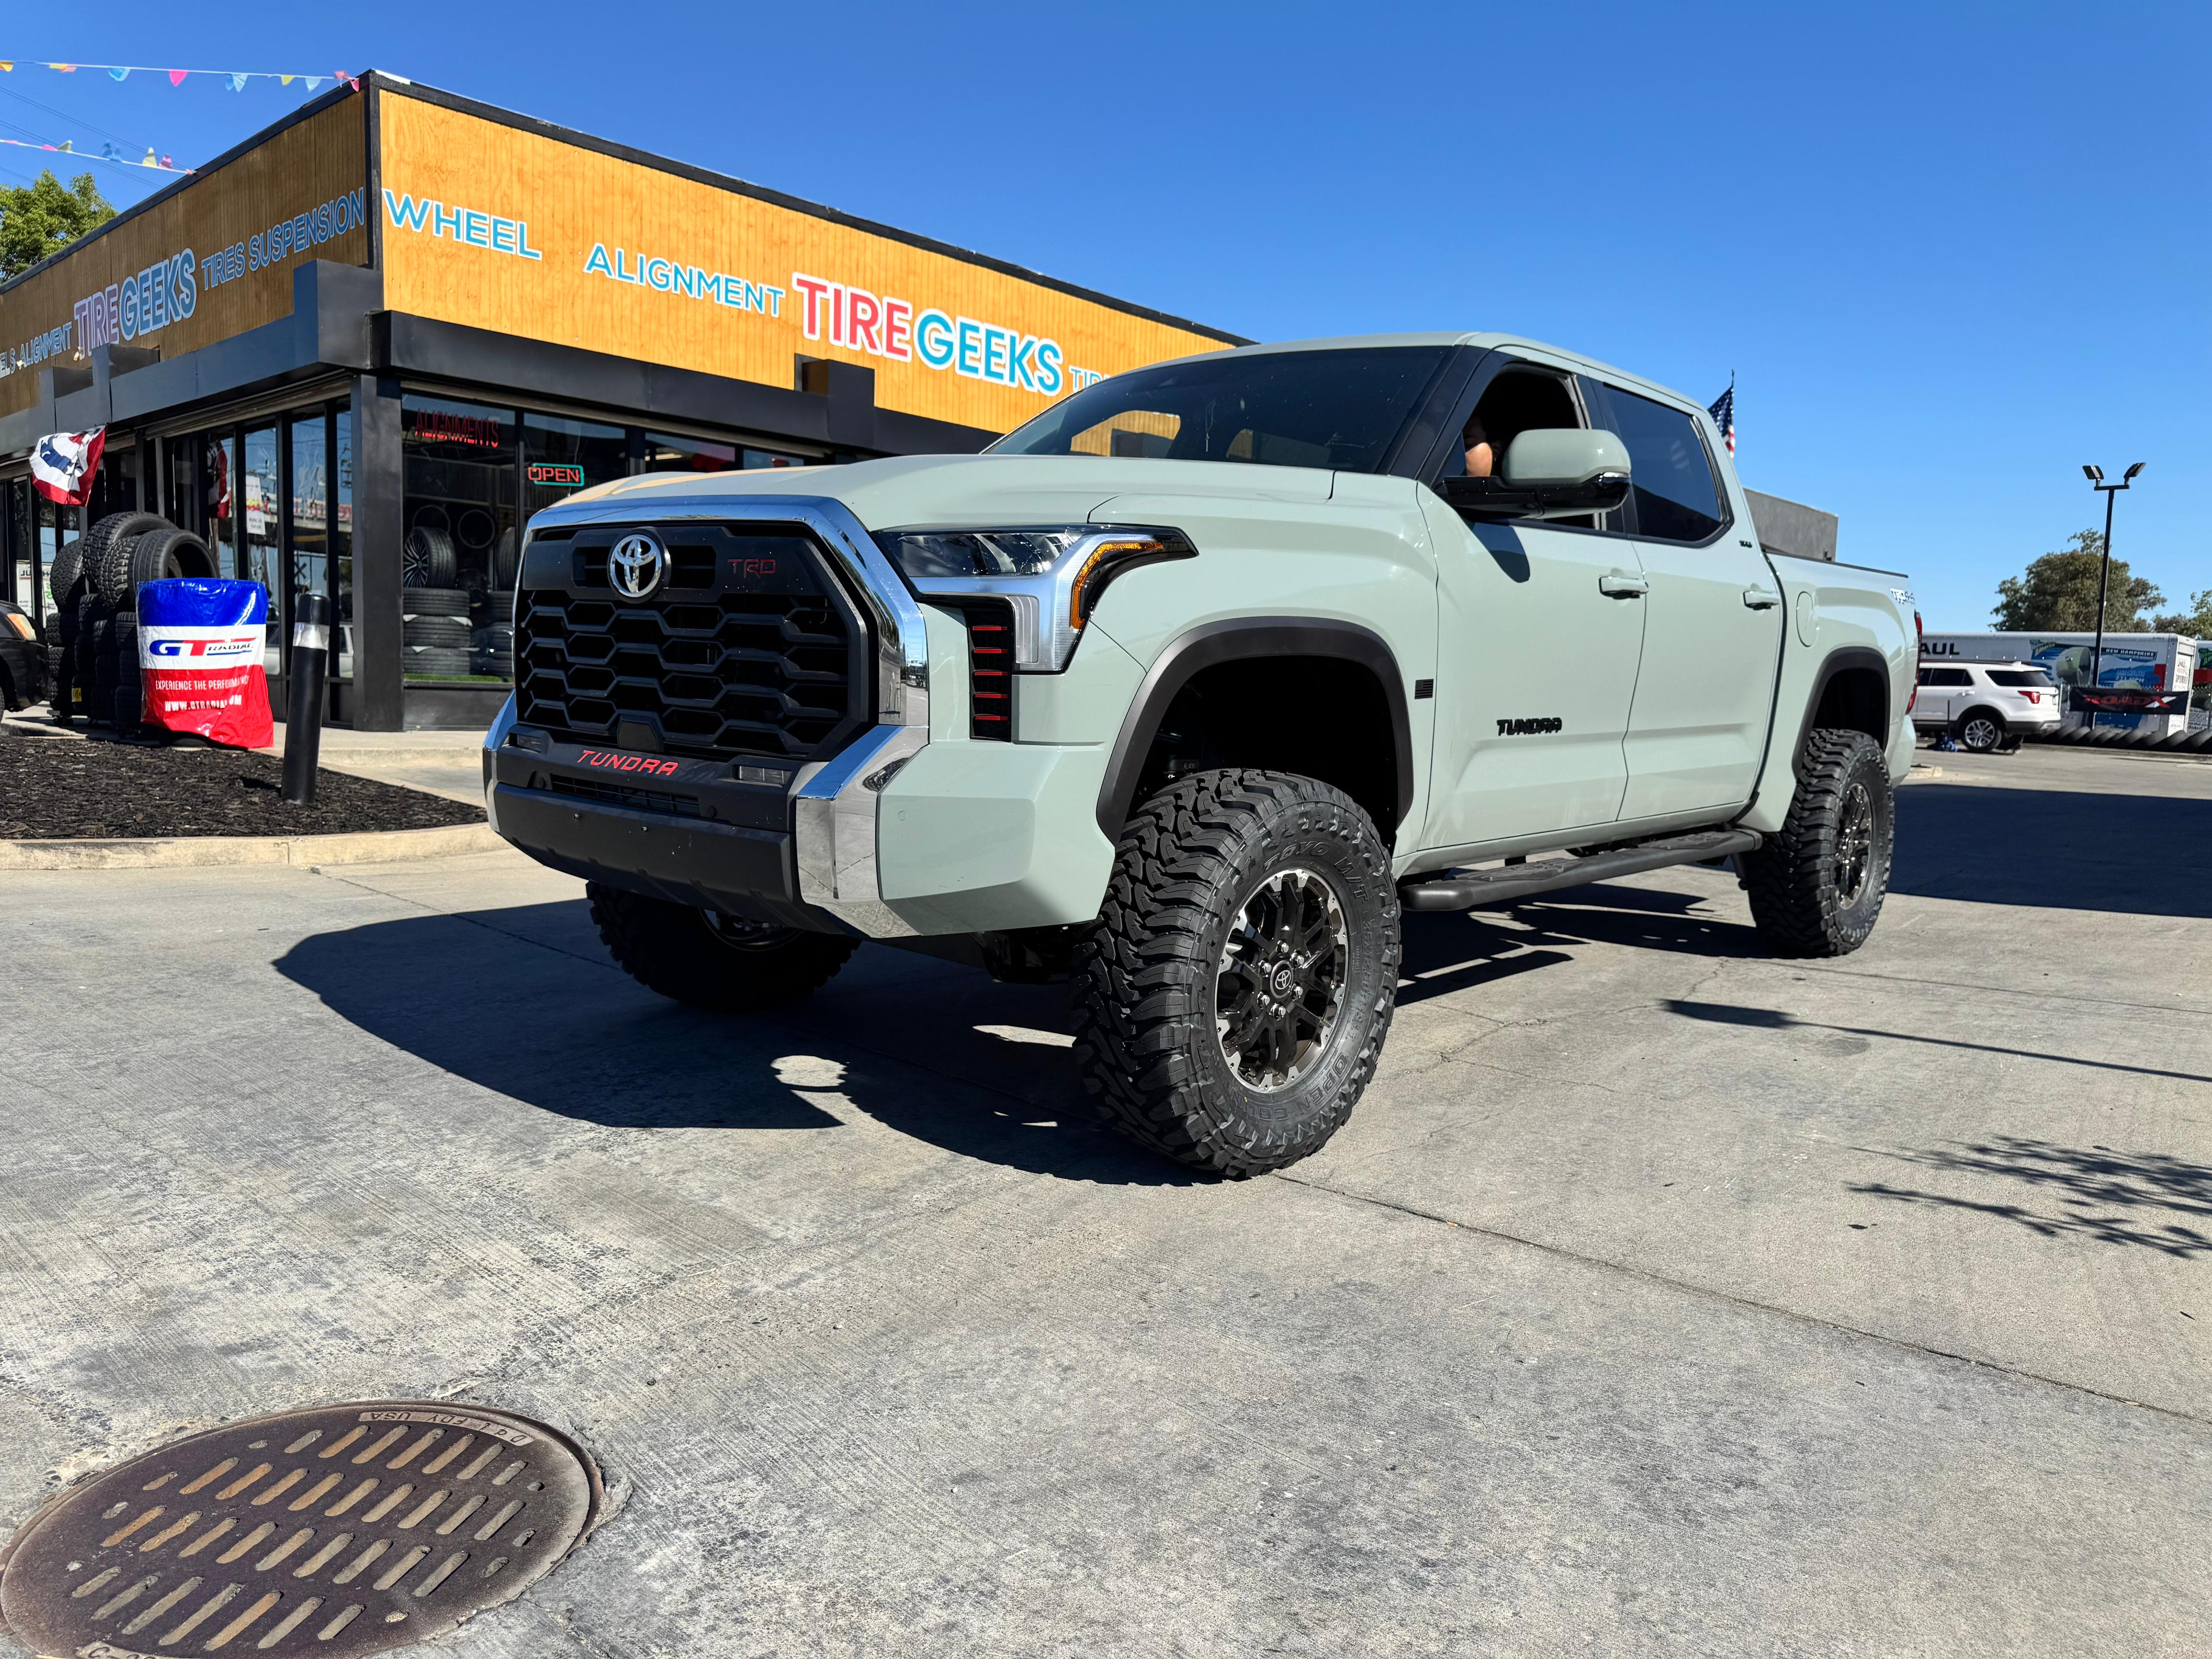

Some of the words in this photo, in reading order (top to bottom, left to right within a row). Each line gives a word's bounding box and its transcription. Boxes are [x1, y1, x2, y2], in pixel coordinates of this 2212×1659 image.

[20, 321, 72, 369] ALIGNMENT
[201, 241, 245, 291] TIRES
[249, 186, 365, 272] SUSPENSION
[381, 187, 542, 261] WHEEL
[583, 242, 785, 318] ALIGNMENT
[1068, 365, 1111, 392] TIR
[415, 408, 499, 448] ALIGNMENTS
[528, 467, 580, 483] OPEN
[728, 558, 777, 579] TRD
[208, 643, 254, 651] RADIAL
[2120, 649, 2155, 657] HAMPSHIRE
[156, 680, 192, 691] EXPERIENCE
[194, 680, 207, 690] THE
[2083, 694, 2177, 709] ROADX
[1496, 717, 1562, 736] TUNDRA
[577, 750, 679, 776] TUNDRA
[1264, 840, 1331, 871] TOYO
[1334, 849, 1369, 900] M/T
[1297, 1051, 1349, 1114] OPEN
[371, 1412, 411, 1420] USA
[426, 1414, 468, 1425] FDY
